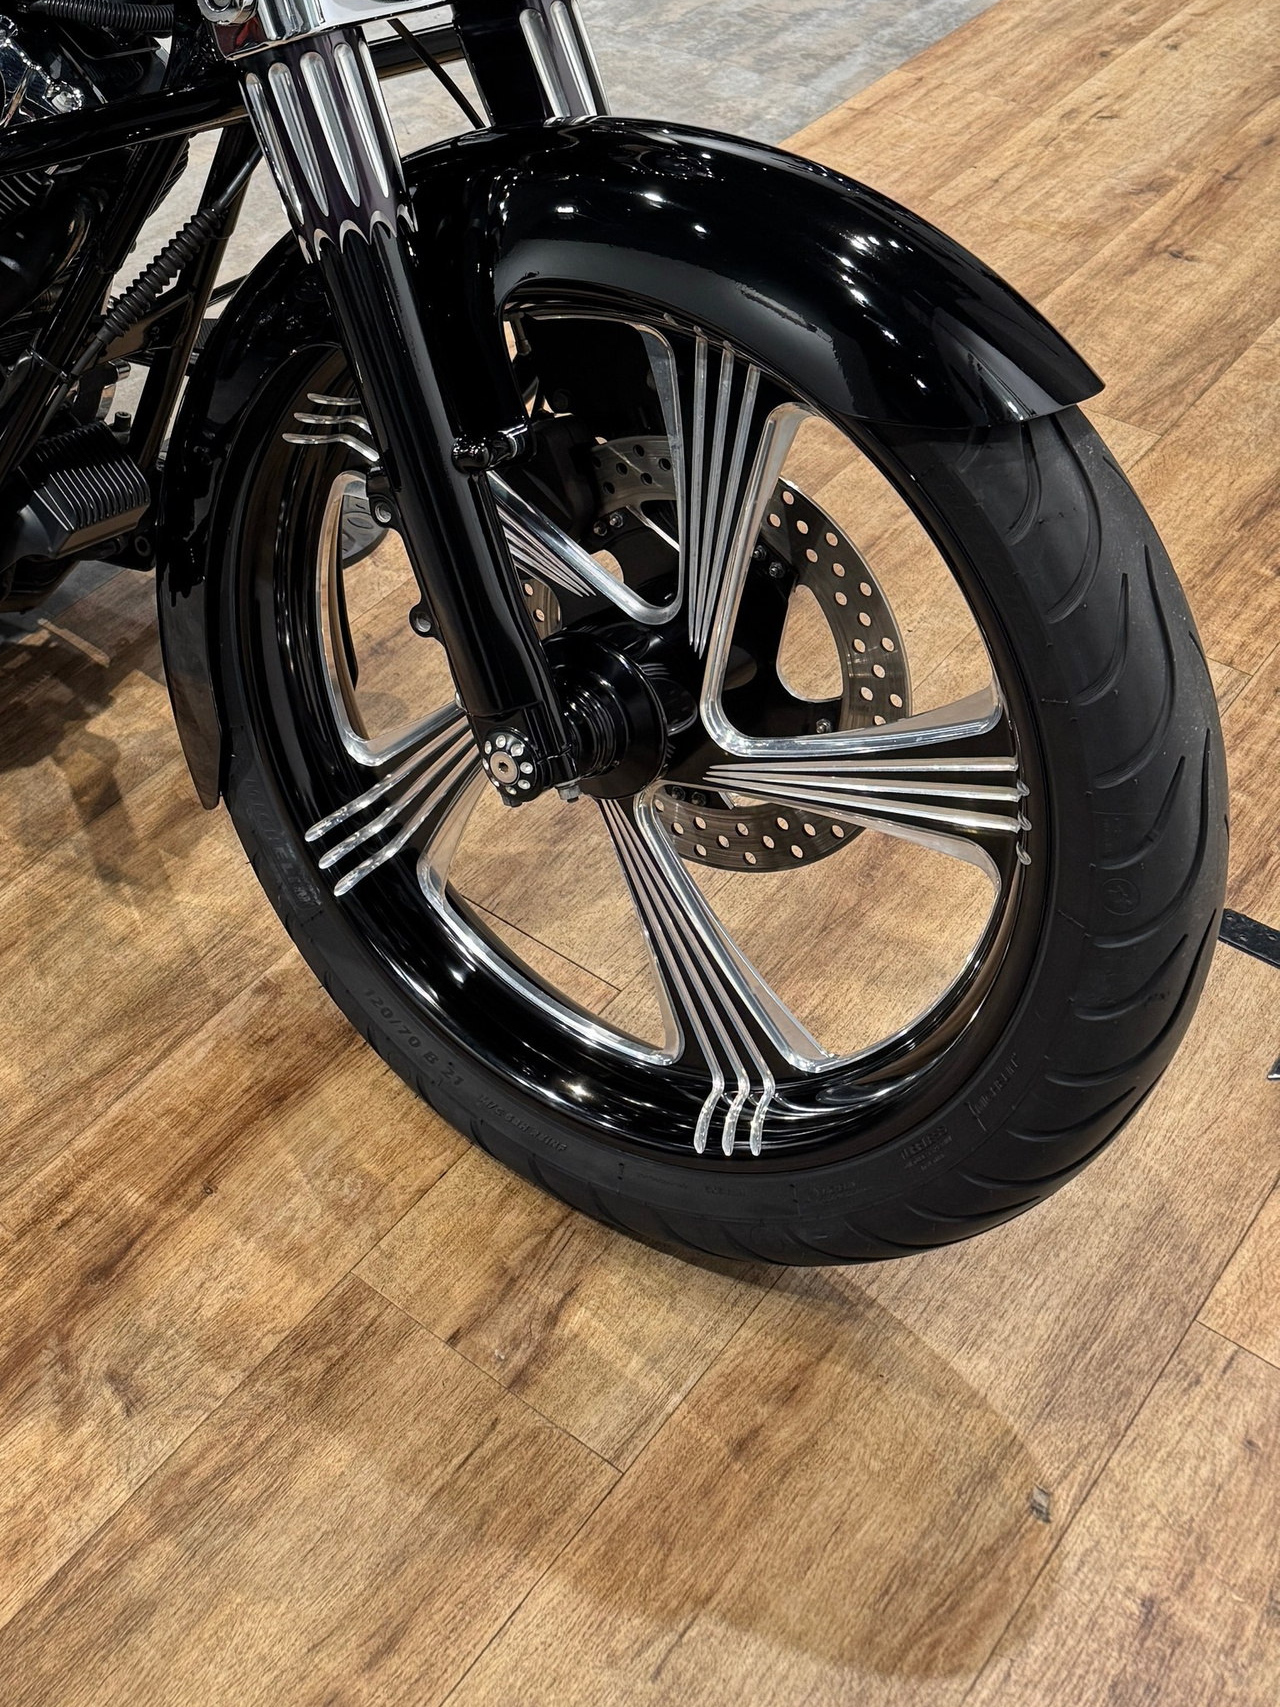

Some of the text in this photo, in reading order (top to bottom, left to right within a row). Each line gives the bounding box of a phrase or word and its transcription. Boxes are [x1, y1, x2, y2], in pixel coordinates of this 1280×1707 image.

[363, 988, 465, 1087] 120/70 B 21
